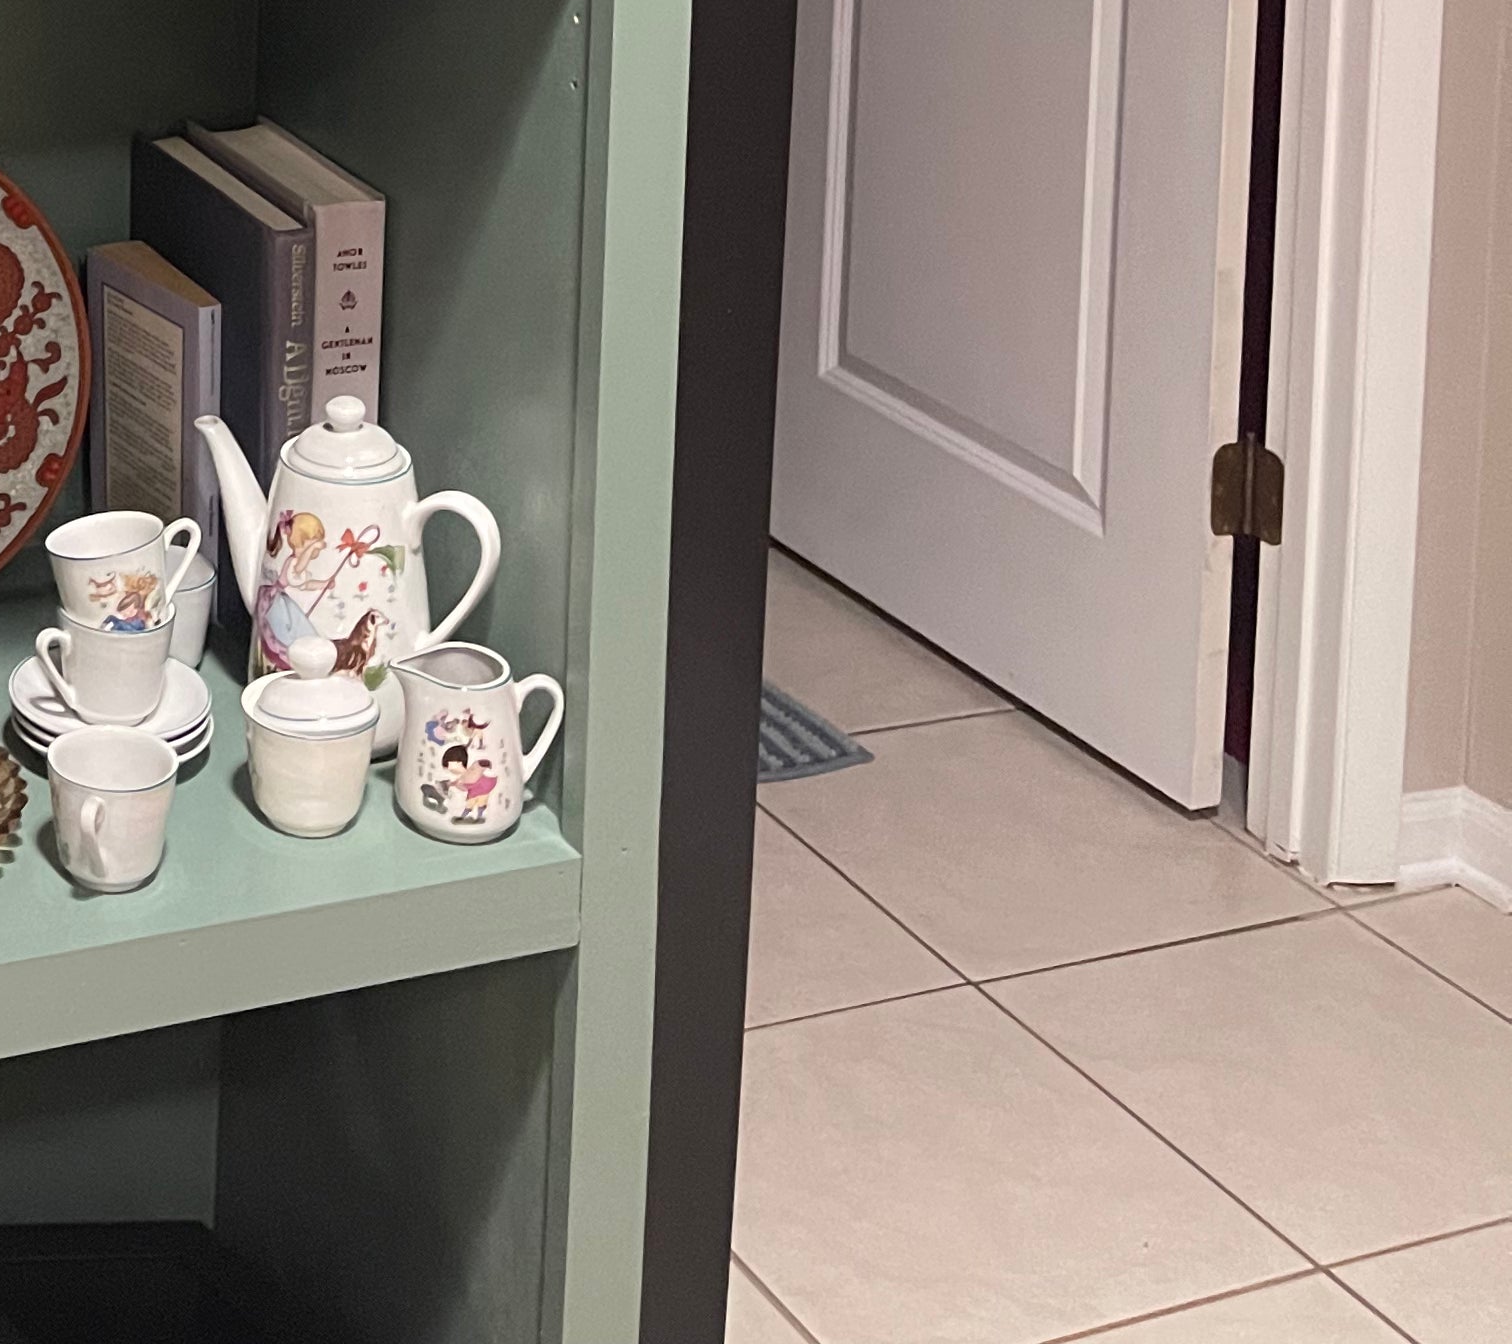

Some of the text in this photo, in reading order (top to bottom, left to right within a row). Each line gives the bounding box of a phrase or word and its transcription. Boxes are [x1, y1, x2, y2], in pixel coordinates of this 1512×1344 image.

[336, 248, 364, 258] AMOR
[333, 261, 368, 272] TOWLES
[290, 243, 306, 327] Silverstein
[344, 326, 350, 334] A
[321, 337, 374, 350] GENTLEMAN
[285, 340, 307, 362] A
[341, 352, 351, 361] IN
[325, 364, 368, 377] MOSCOW
